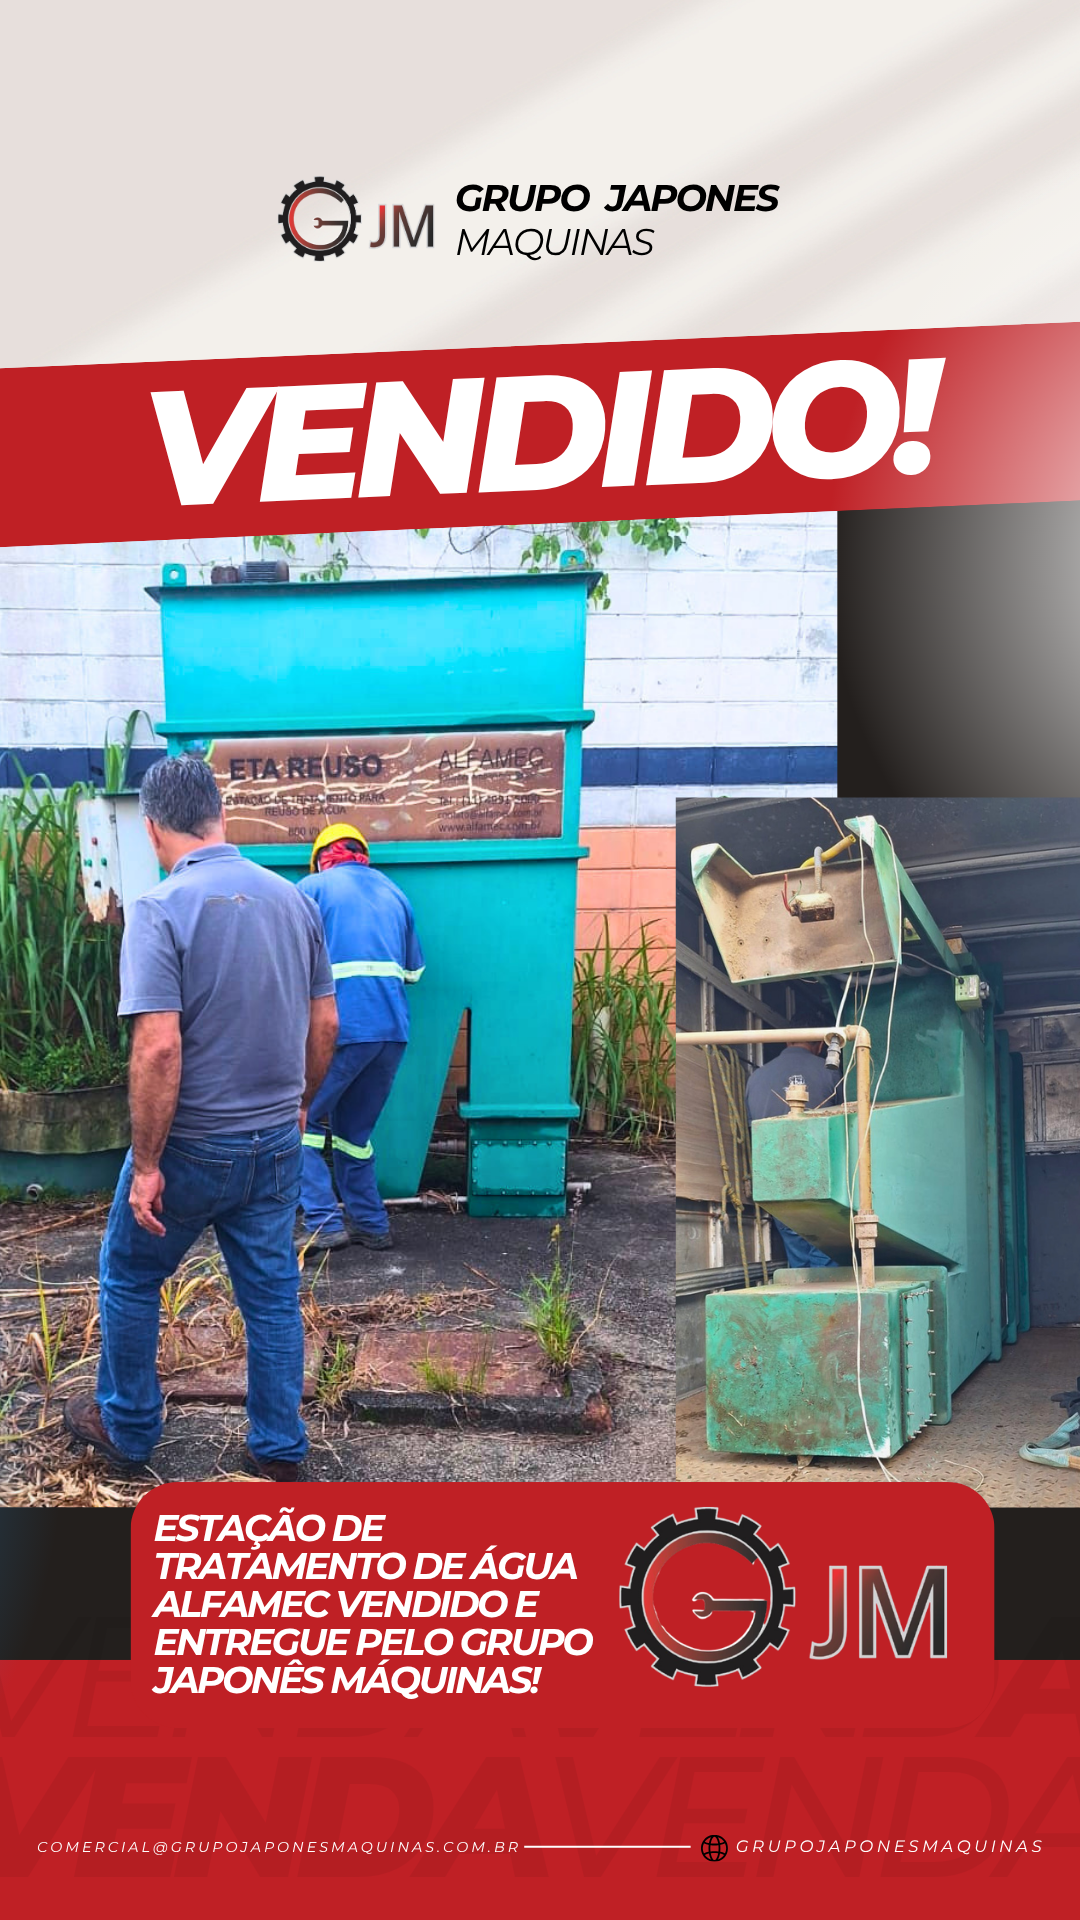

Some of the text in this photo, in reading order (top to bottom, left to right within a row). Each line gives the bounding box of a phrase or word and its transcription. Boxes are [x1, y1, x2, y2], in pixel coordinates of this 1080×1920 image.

[229, 753, 384, 781] ETA REUSO
[438, 747, 544, 770] ALFAMEC
[264, 807, 300, 817] REUSO
[303, 806, 317, 817] DE
